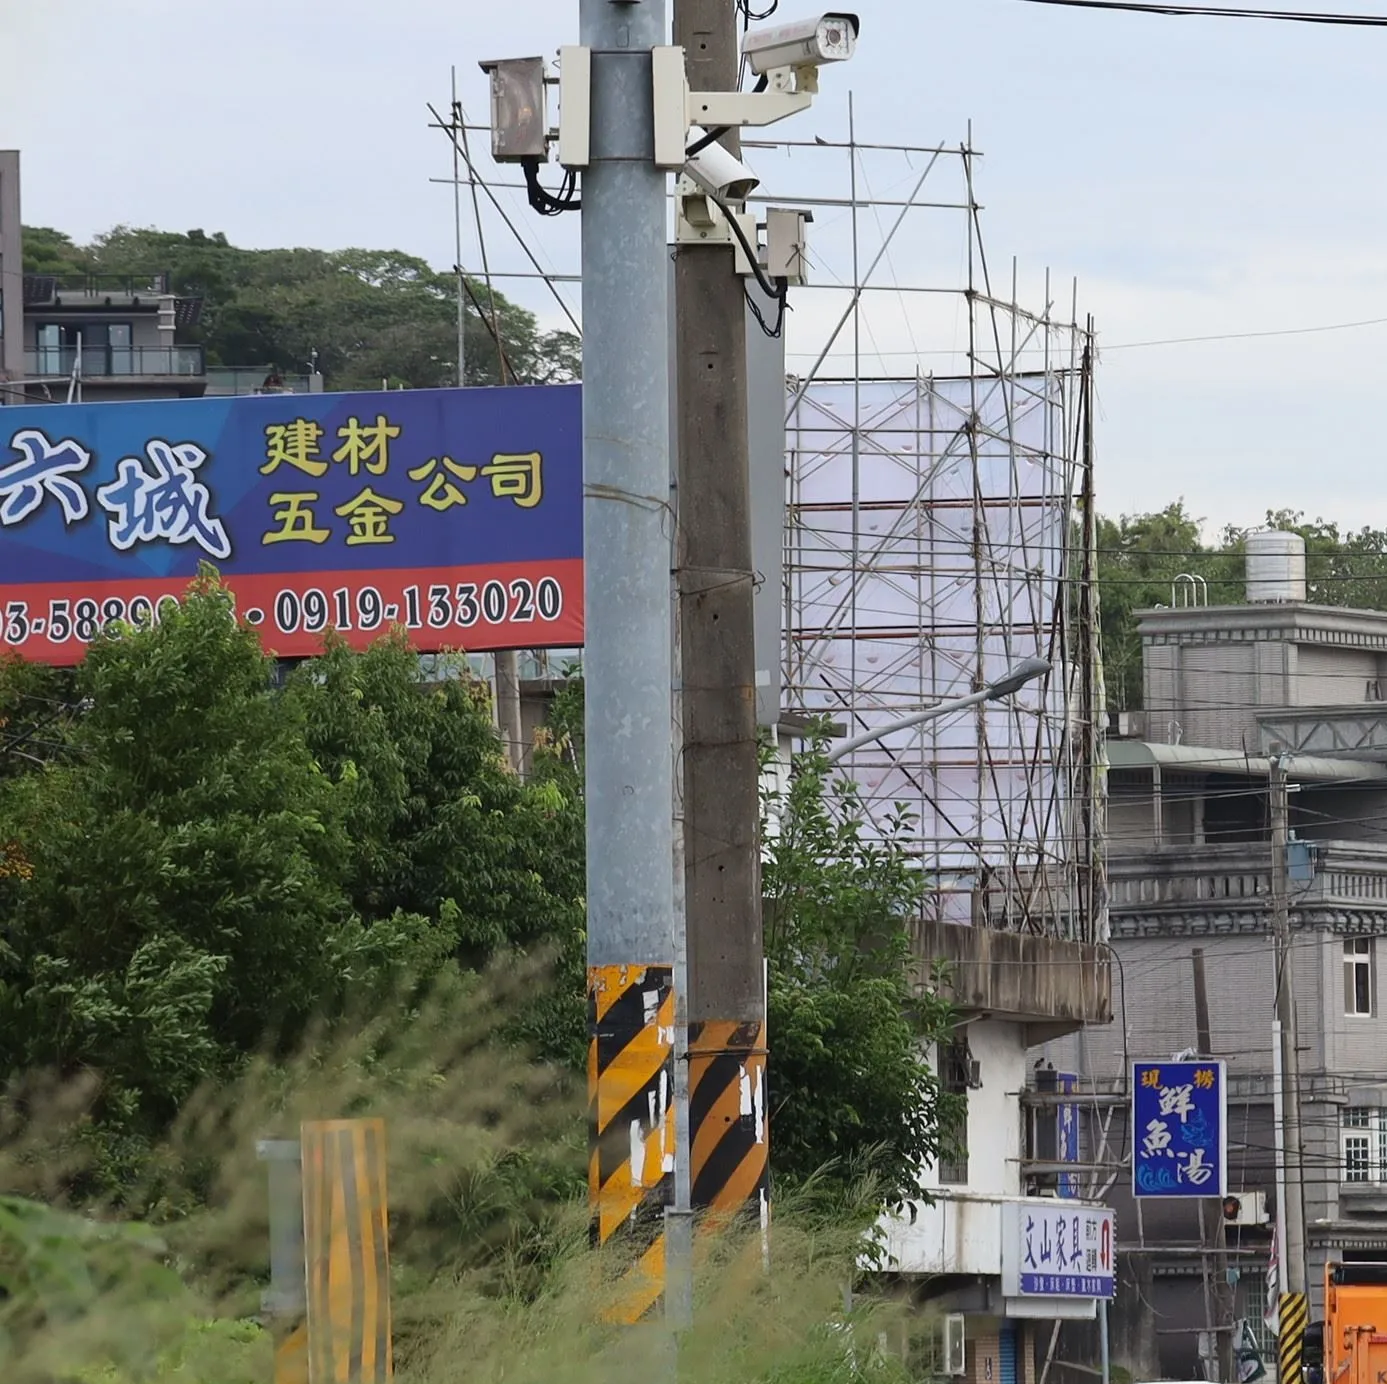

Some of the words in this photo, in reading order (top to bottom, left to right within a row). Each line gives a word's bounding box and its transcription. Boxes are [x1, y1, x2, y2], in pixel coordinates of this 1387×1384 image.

[260, 416, 401, 478] 建材
[408, 451, 542, 511] 公司
[262, 488, 403, 547] 五金
[274, 576, 563, 632] 0919-133020
[1139, 1083, 1214, 1185] 鮮魚湯
[1024, 1214, 1083, 1273] 文山家具
